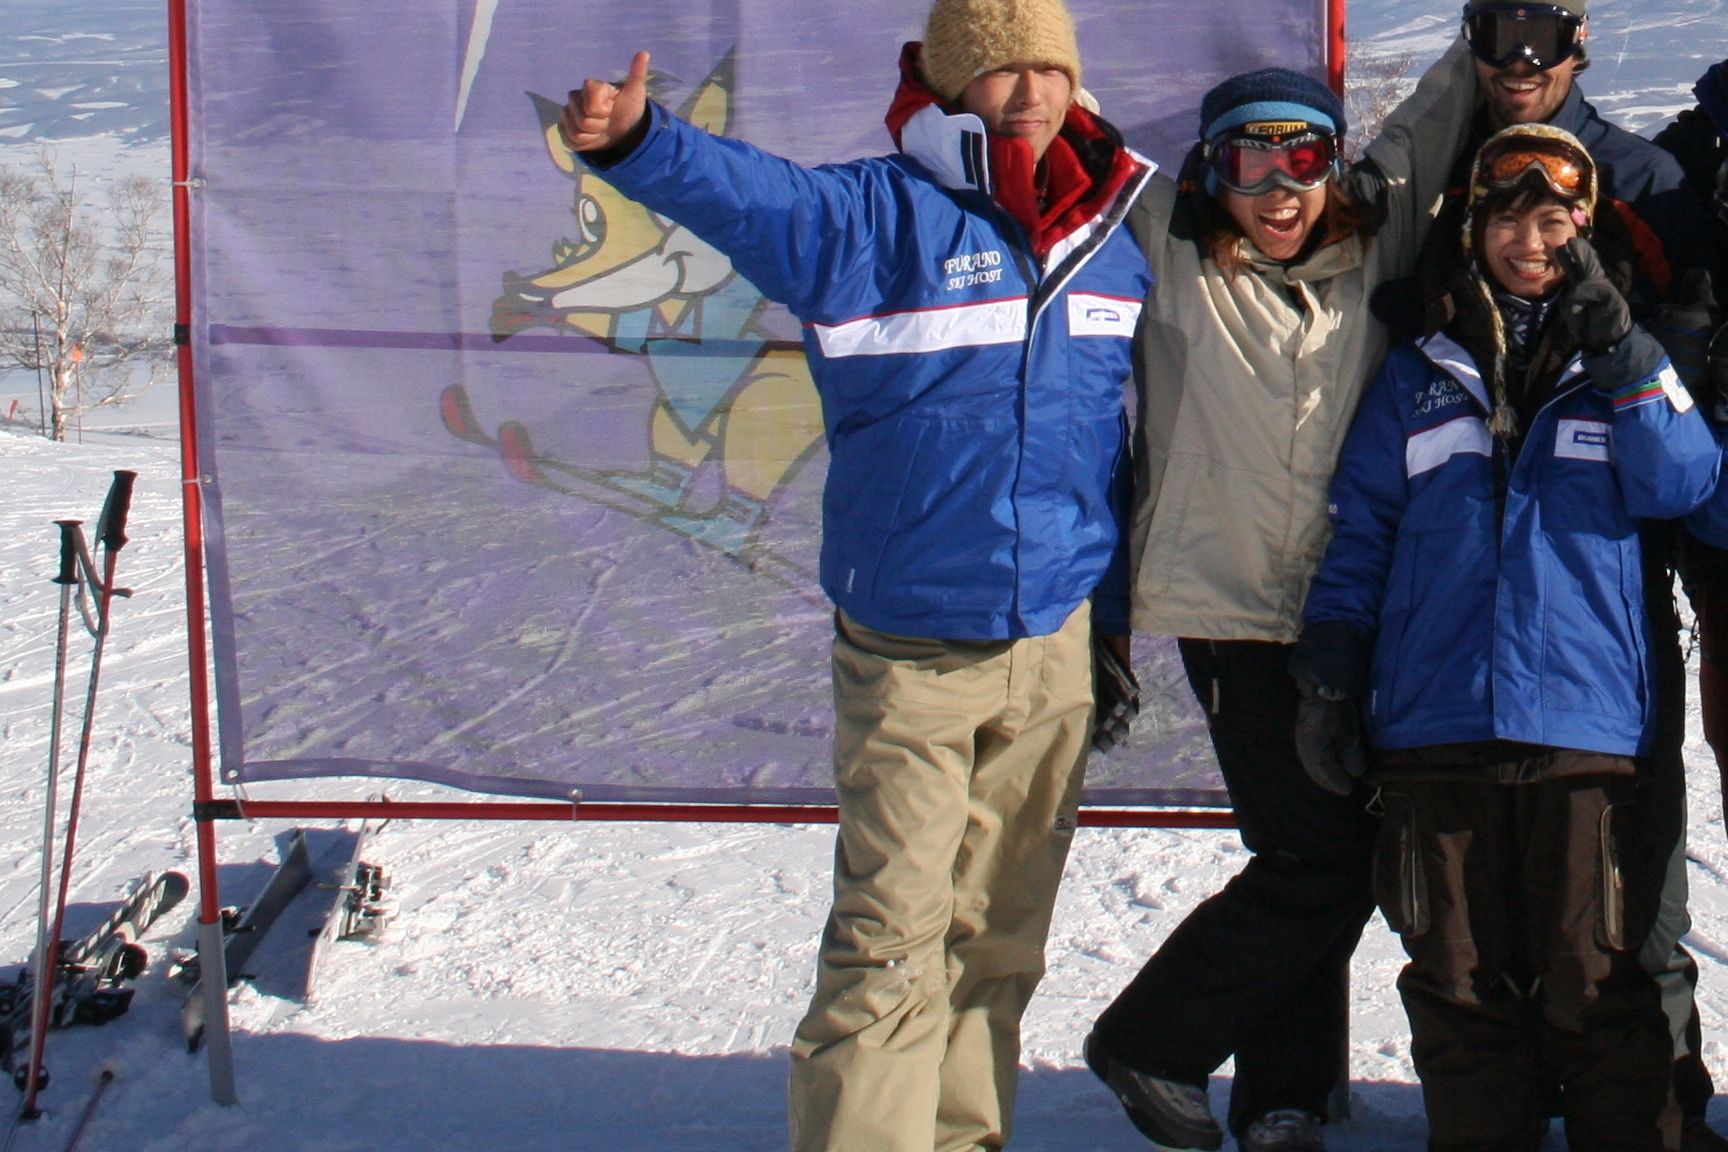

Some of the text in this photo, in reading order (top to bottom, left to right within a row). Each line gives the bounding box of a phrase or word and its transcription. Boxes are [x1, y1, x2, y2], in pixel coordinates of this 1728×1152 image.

[944, 250, 1001, 274] FURANO
[946, 268, 1003, 291] SKI HOST
